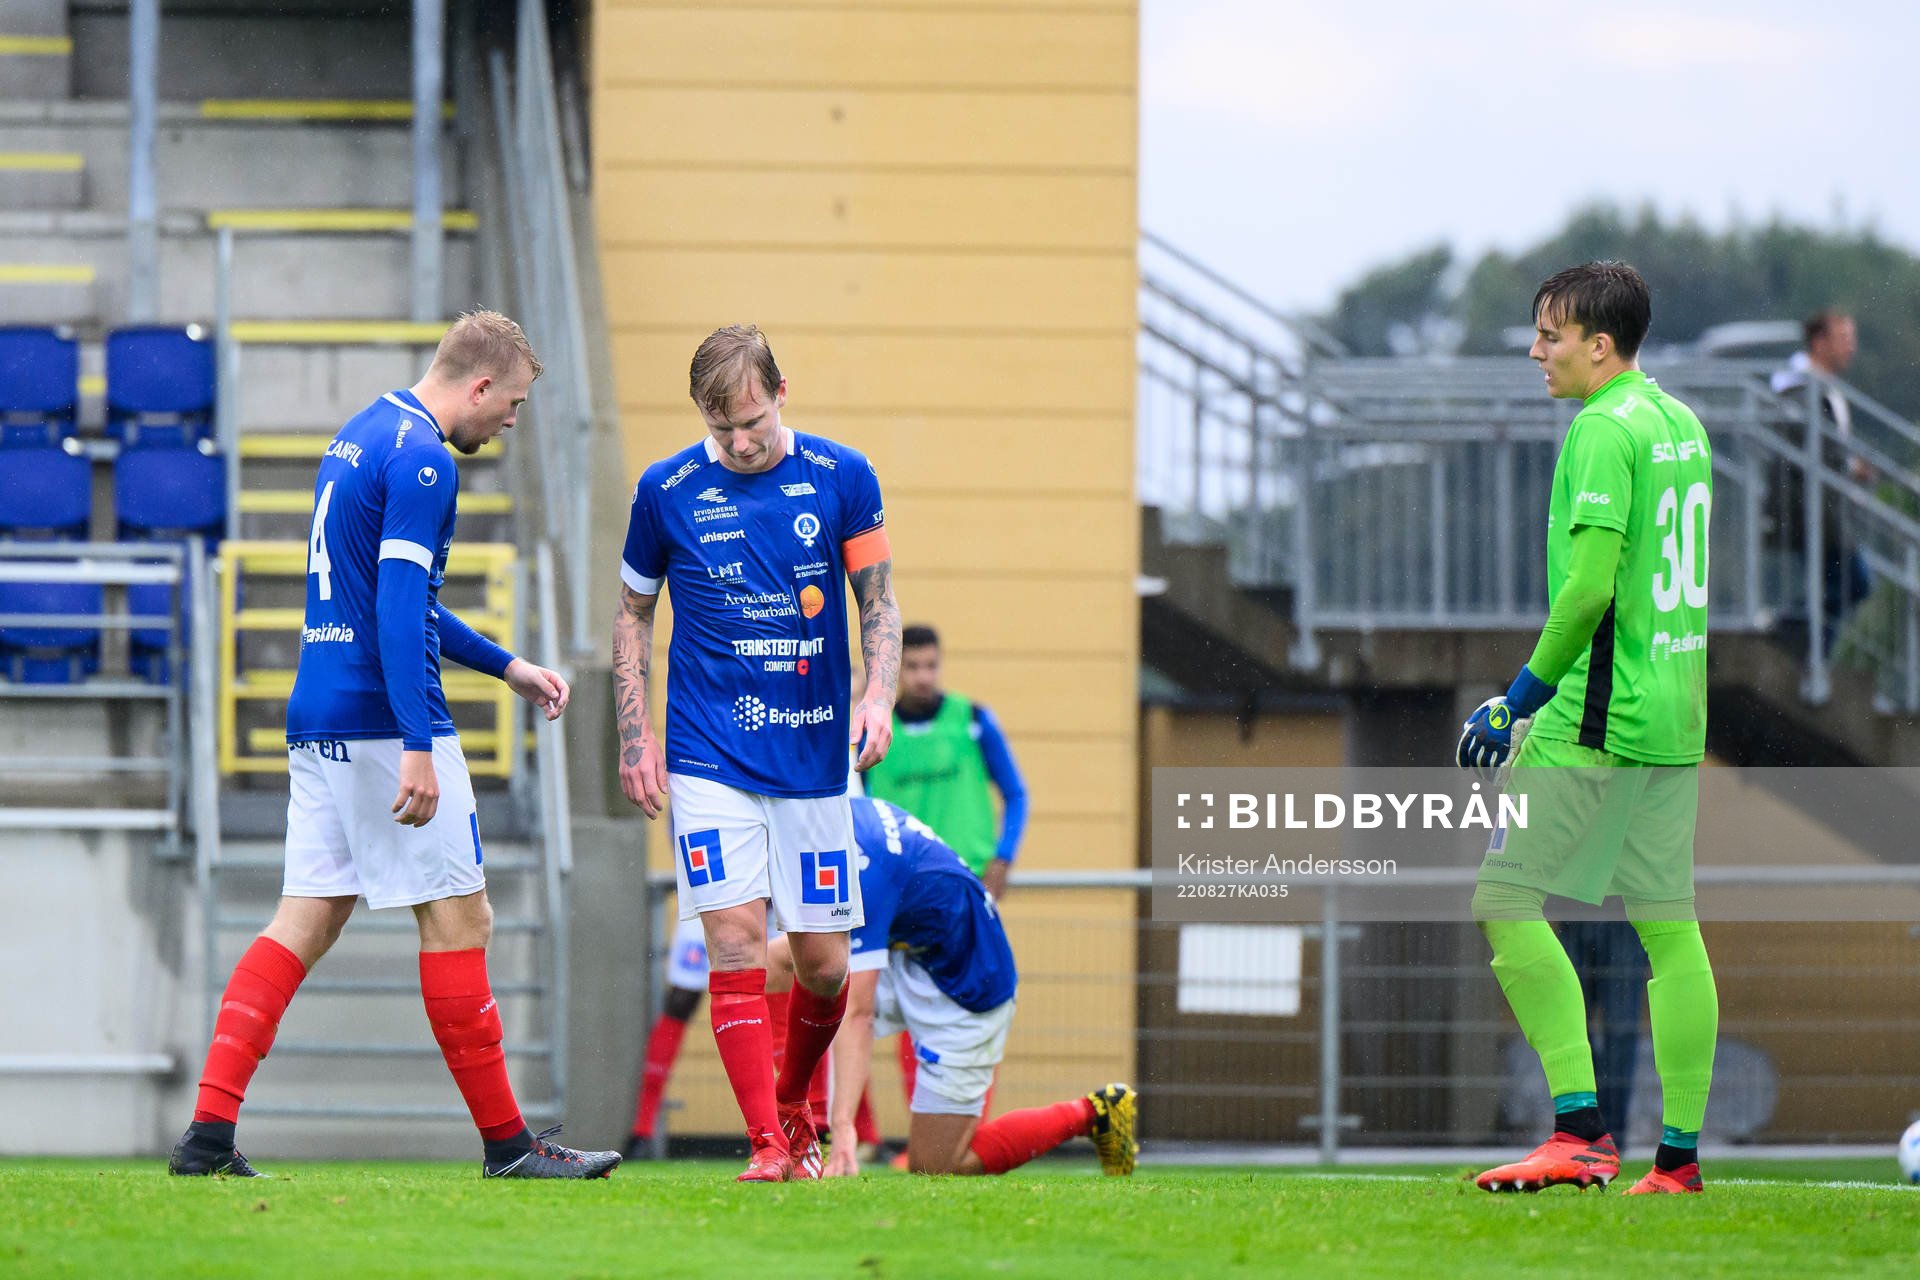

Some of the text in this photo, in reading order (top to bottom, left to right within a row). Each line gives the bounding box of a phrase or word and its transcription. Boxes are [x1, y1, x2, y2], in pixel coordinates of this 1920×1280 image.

[324, 439, 363, 468] CANFIL
[661, 459, 698, 491] MINEC
[309, 481, 334, 600] 4
[700, 529, 746, 543] uhlsport
[1652, 482, 1711, 612] 30
[707, 562, 743, 578] LMT
[742, 604, 798, 620] Sparbank
[302, 622, 354, 649] askinia
[732, 639, 799, 656] TERNSTEDT
[764, 660, 796, 672] COMFORT
